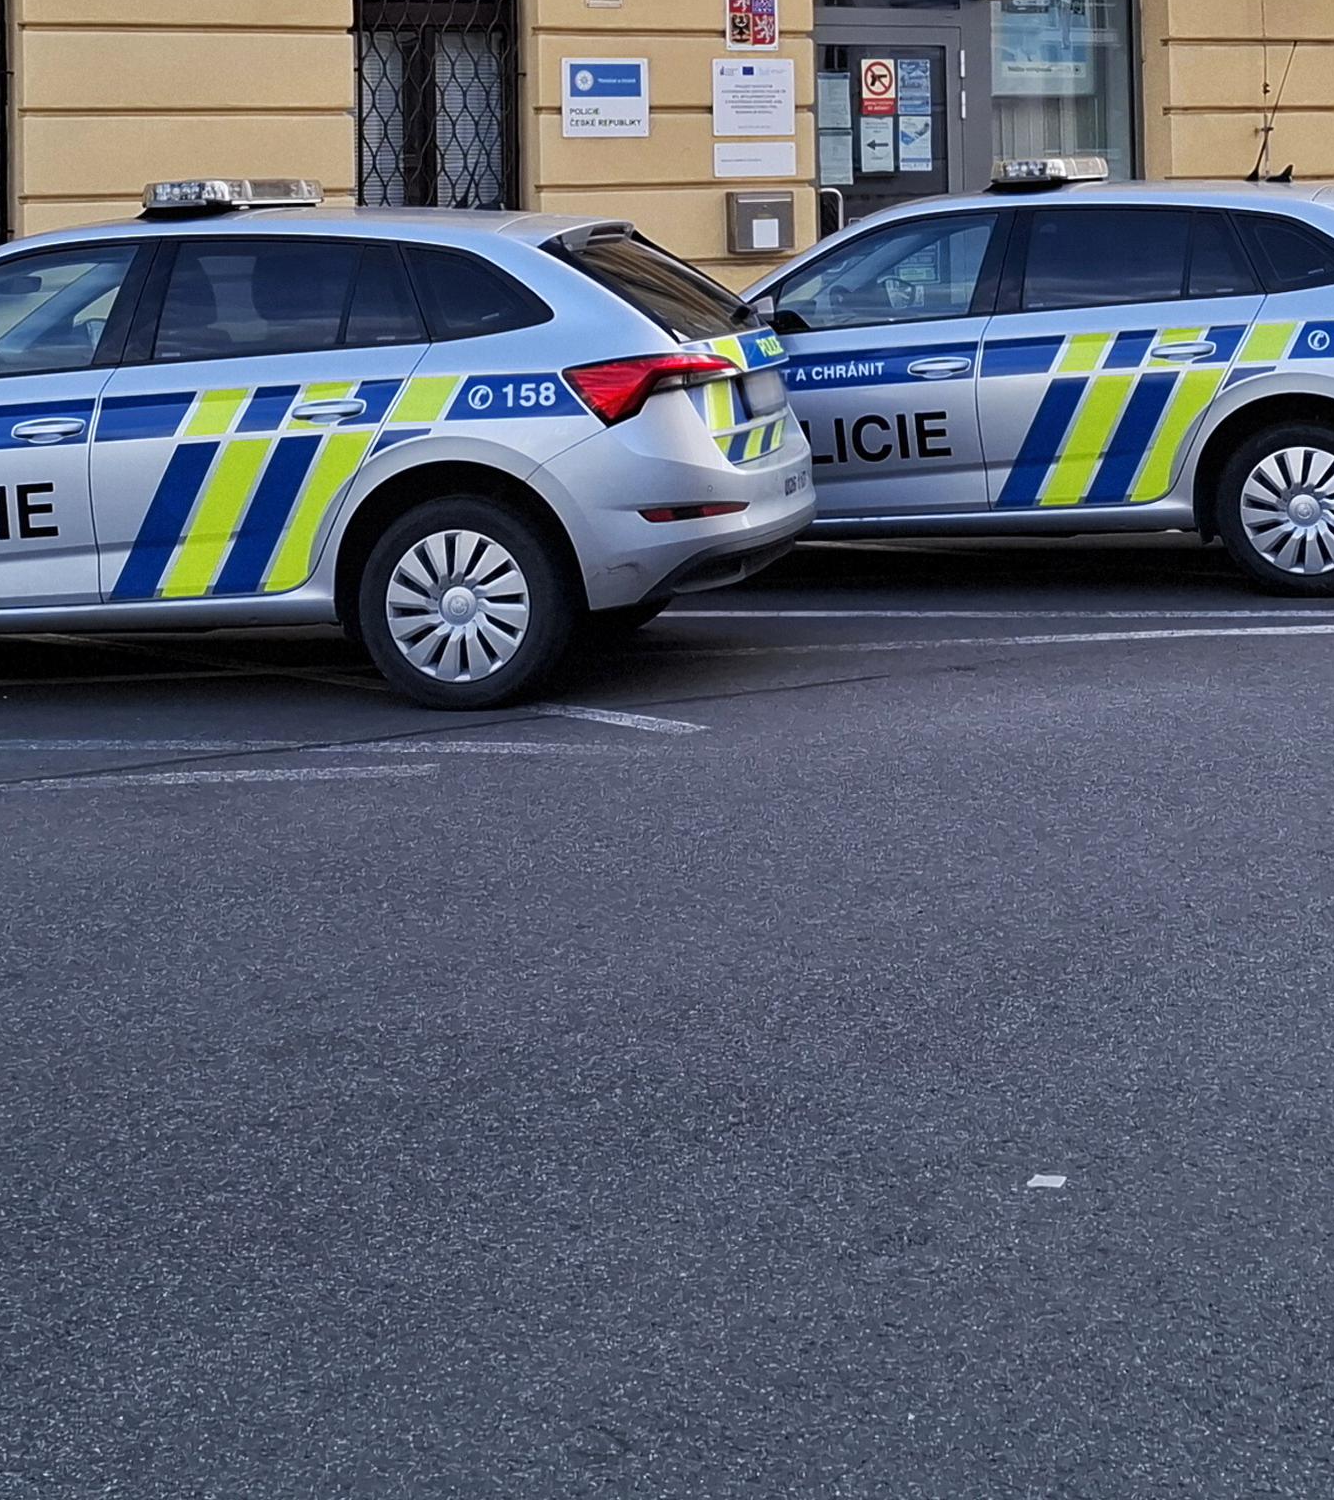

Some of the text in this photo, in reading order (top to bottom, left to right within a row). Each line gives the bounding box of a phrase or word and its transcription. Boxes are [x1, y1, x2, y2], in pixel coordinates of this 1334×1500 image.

[569, 107, 600, 115] POLICIE
[795, 367, 807, 382] A
[811, 360, 885, 380] CHRÁNIT
[501, 381, 557, 408] 158
[799, 411, 953, 465] LICIE
